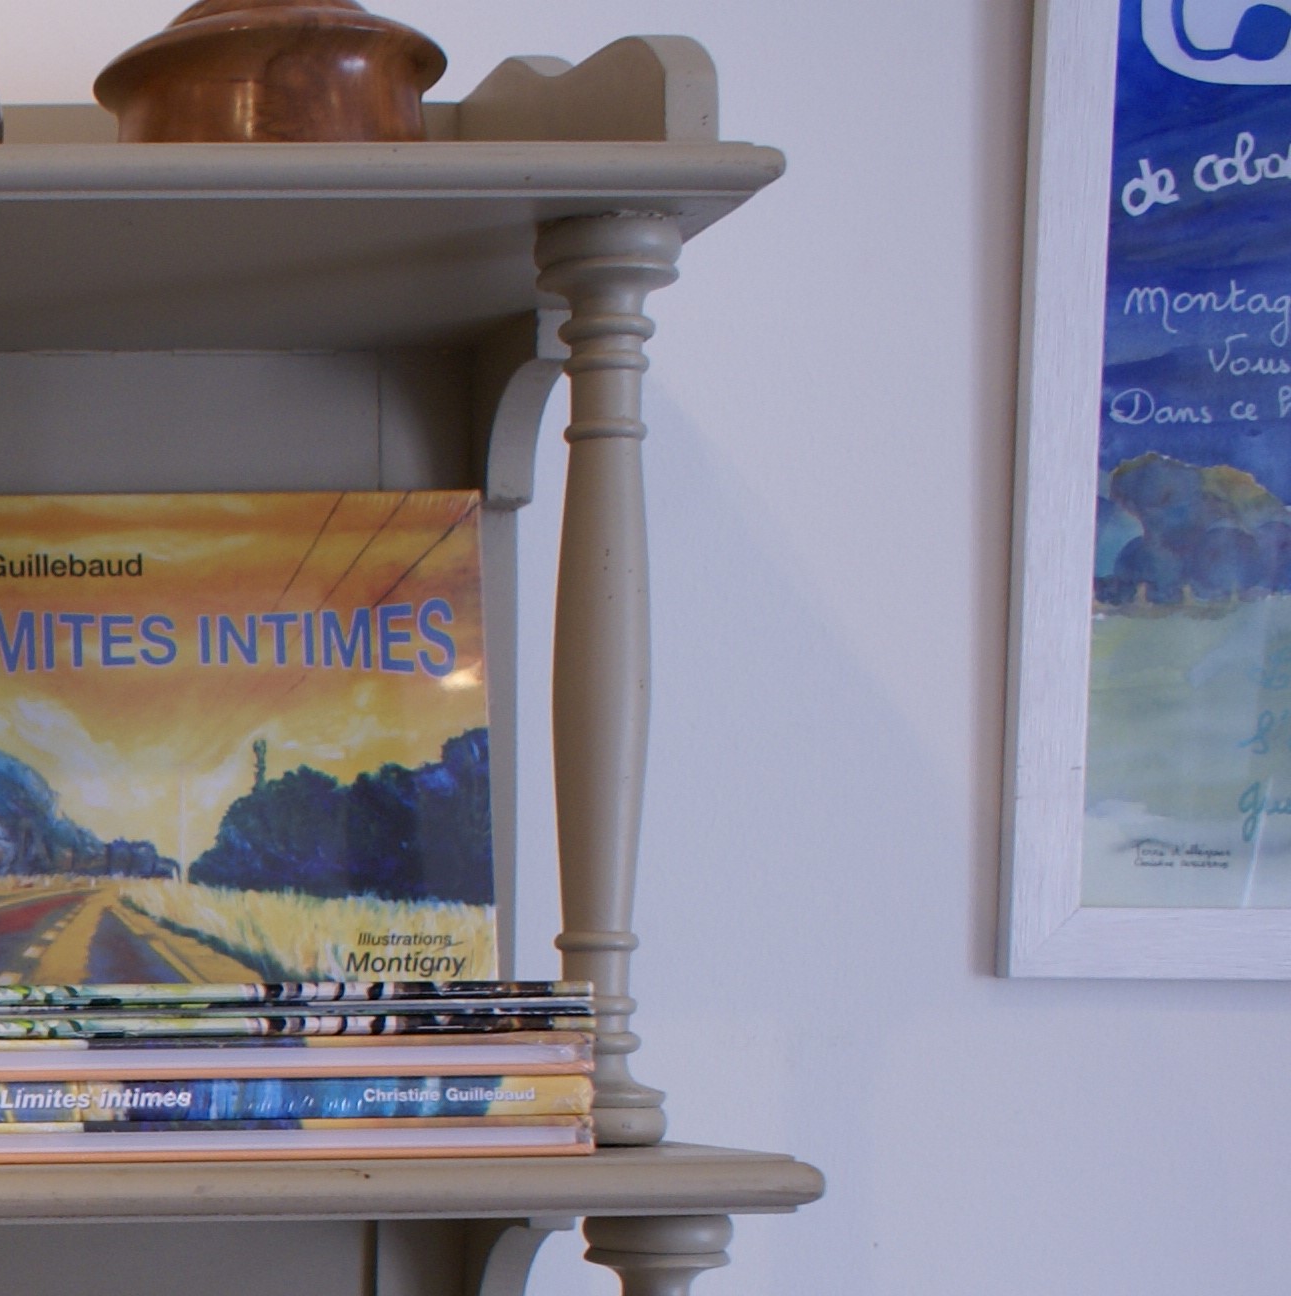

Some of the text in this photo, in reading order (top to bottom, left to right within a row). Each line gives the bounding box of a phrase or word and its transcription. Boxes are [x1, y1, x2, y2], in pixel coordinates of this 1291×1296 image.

[1122, 160, 1180, 216] de
[1230, 400, 1258, 421] ce
[198, 597, 459, 679] INTIMES
[357, 933, 452, 946] Illustrations
[346, 951, 466, 977] Montigny
[0, 1086, 91, 1111] Limites
[363, 1086, 440, 1104] Christine
[445, 1085, 535, 1104] Guillebaud
